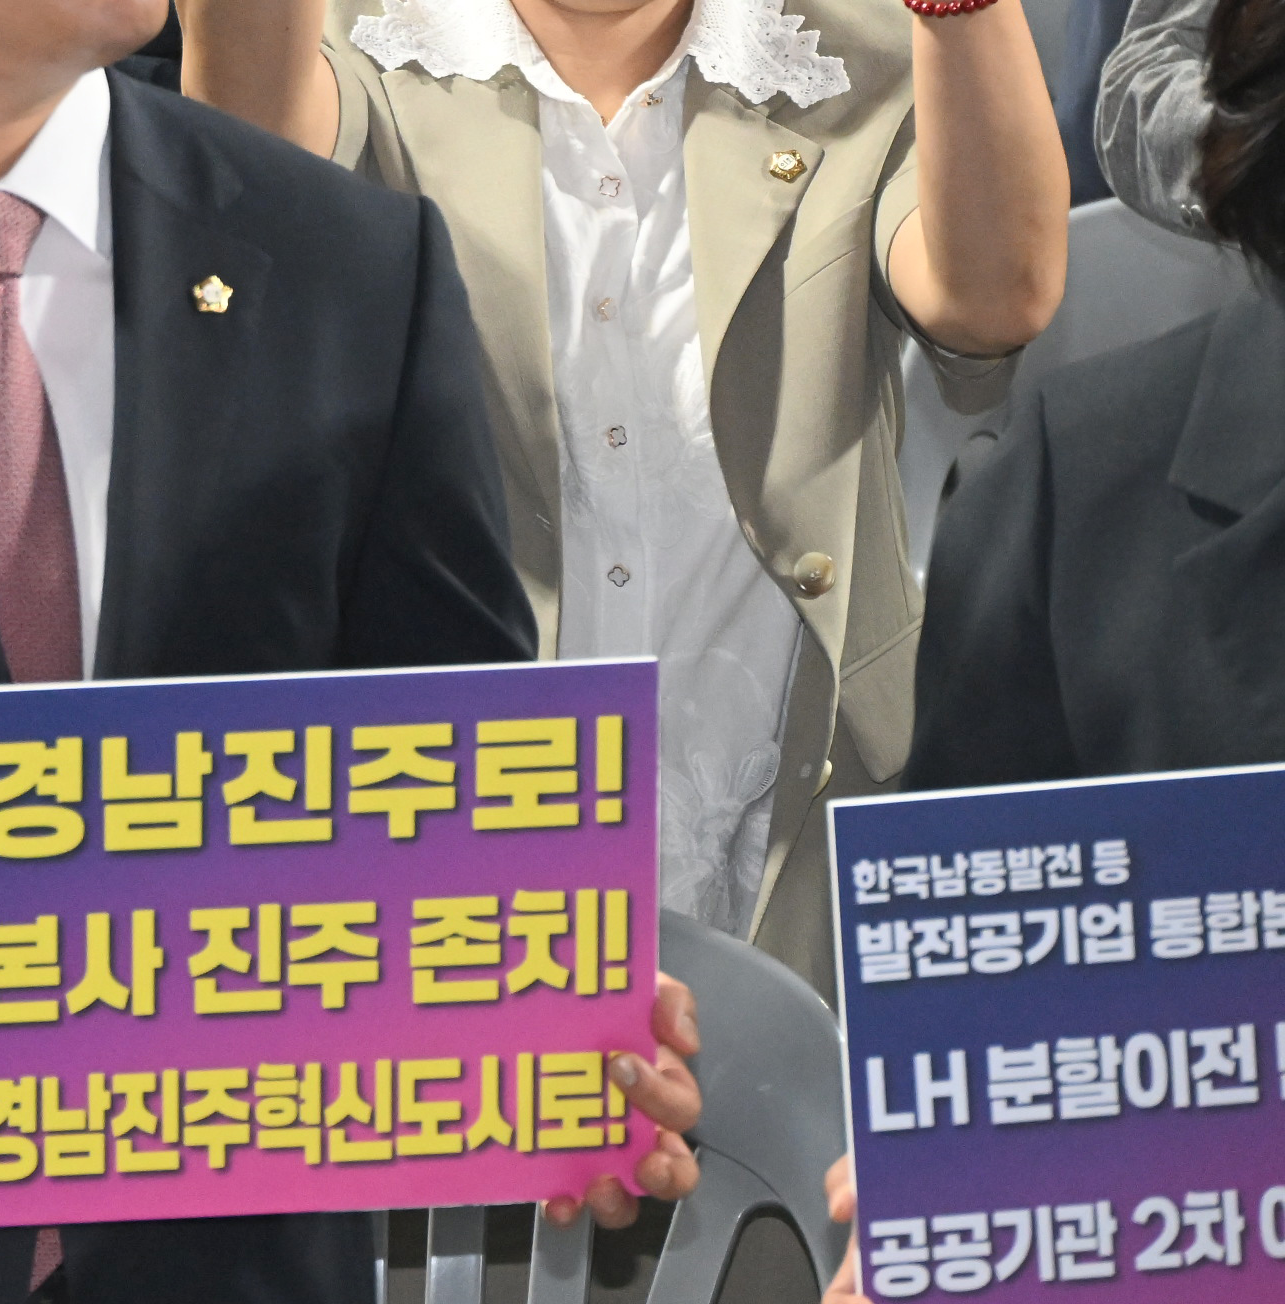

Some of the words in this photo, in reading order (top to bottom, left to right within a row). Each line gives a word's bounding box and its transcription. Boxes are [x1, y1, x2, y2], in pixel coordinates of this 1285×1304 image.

[852, 842, 1082, 904] 한국남동발전
[1092, 839, 1130, 887] 등
[188, 901, 380, 1016] 진주
[409, 888, 629, 1005] 존치!
[856, 902, 1136, 984] 발전공기업
[866, 1050, 970, 1133] LH
[986, 1023, 1260, 1126] 분할이전
[869, 1201, 1117, 1298] 공공기관
[1131, 1189, 1246, 1272] 2차
